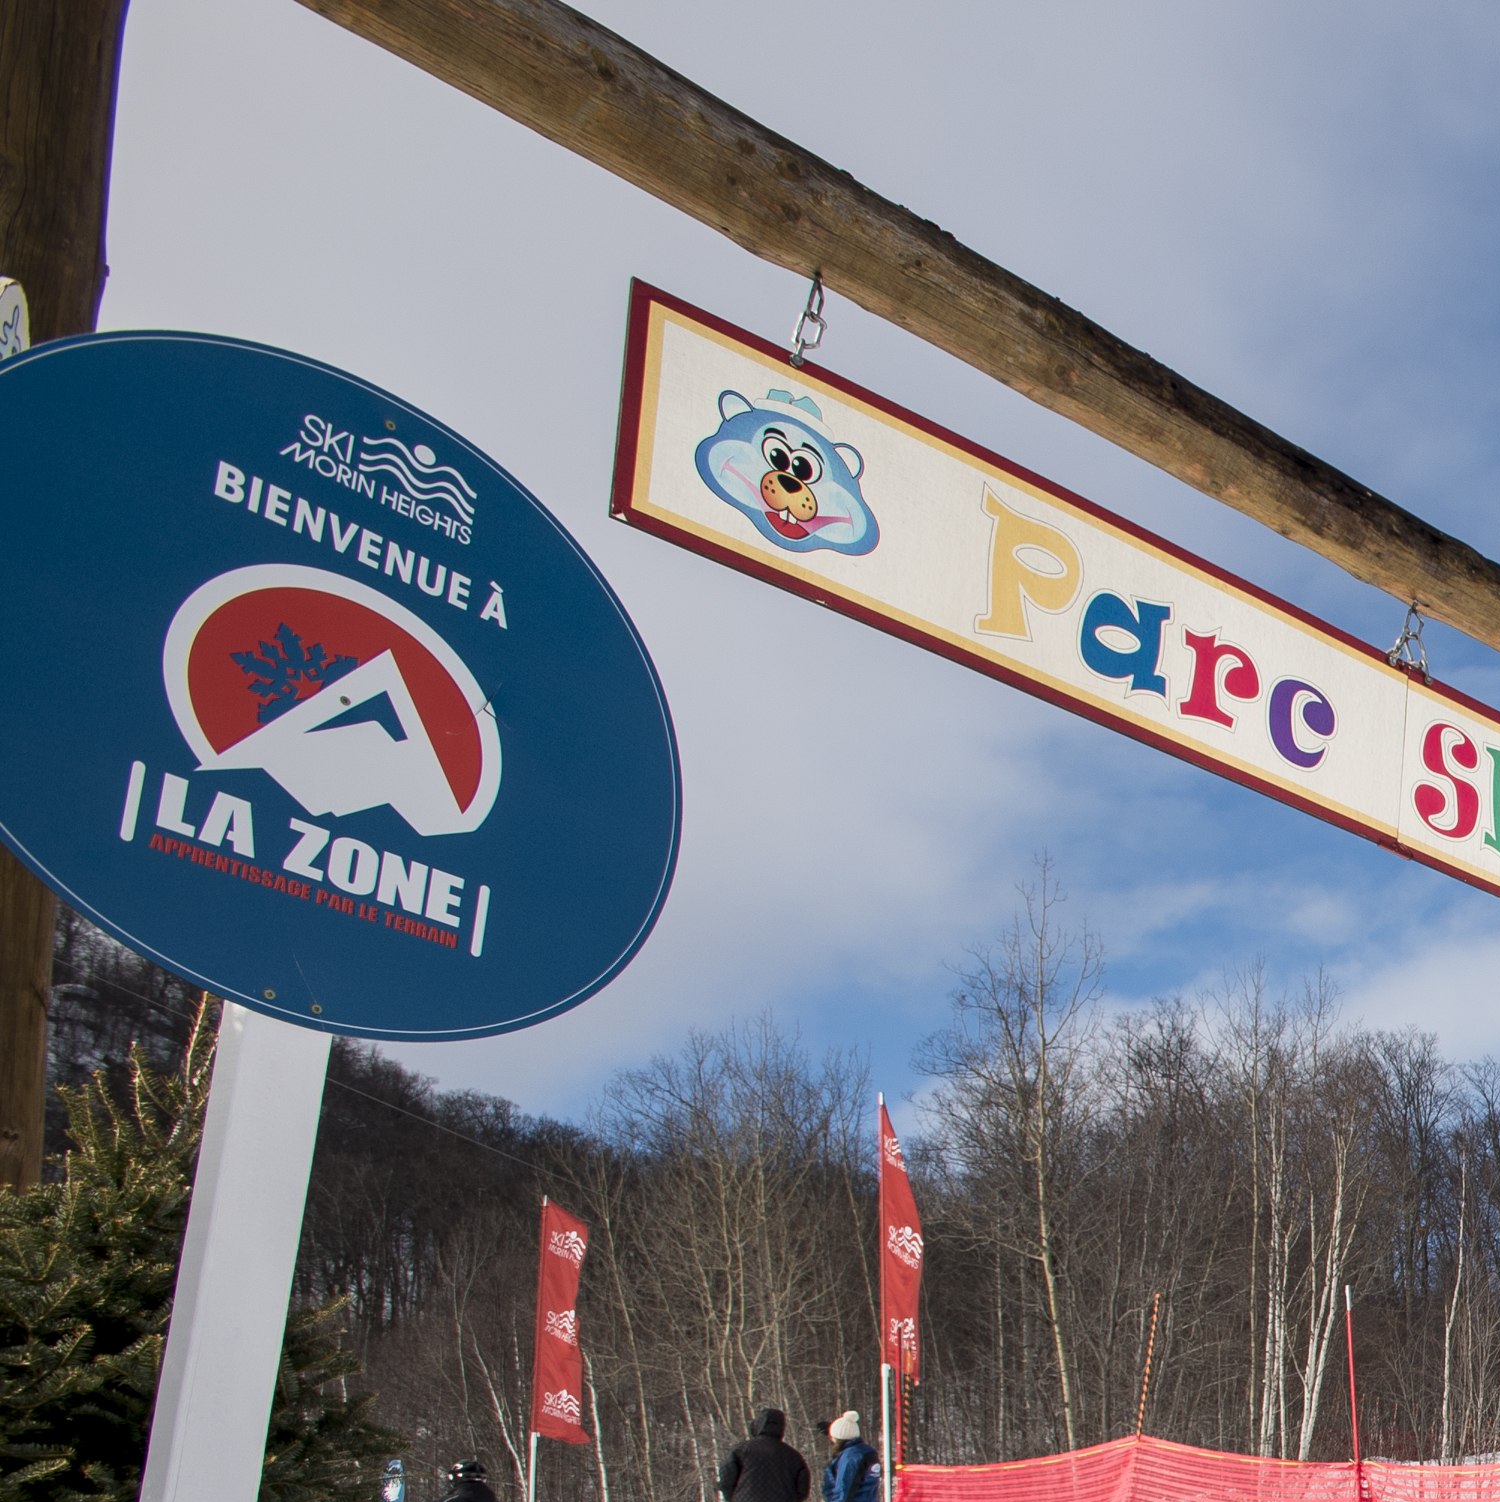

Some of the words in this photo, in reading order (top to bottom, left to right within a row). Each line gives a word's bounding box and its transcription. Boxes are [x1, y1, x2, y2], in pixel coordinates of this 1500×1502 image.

[279, 442, 376, 499] MORIN
[381, 485, 473, 545] HEIGHTS
[300, 414, 355, 464] SKI
[213, 459, 474, 612] BIENVENUE
[480, 580, 509, 630] À
[975, 485, 1337, 771] Parc
[149, 833, 311, 901] APPRENTISSAGE
[315, 889, 355, 915] PAR
[358, 903, 378, 923] LE
[384, 911, 458, 949] TERRAIN
[155, 771, 255, 859] LA
[282, 817, 465, 928] ZONE
